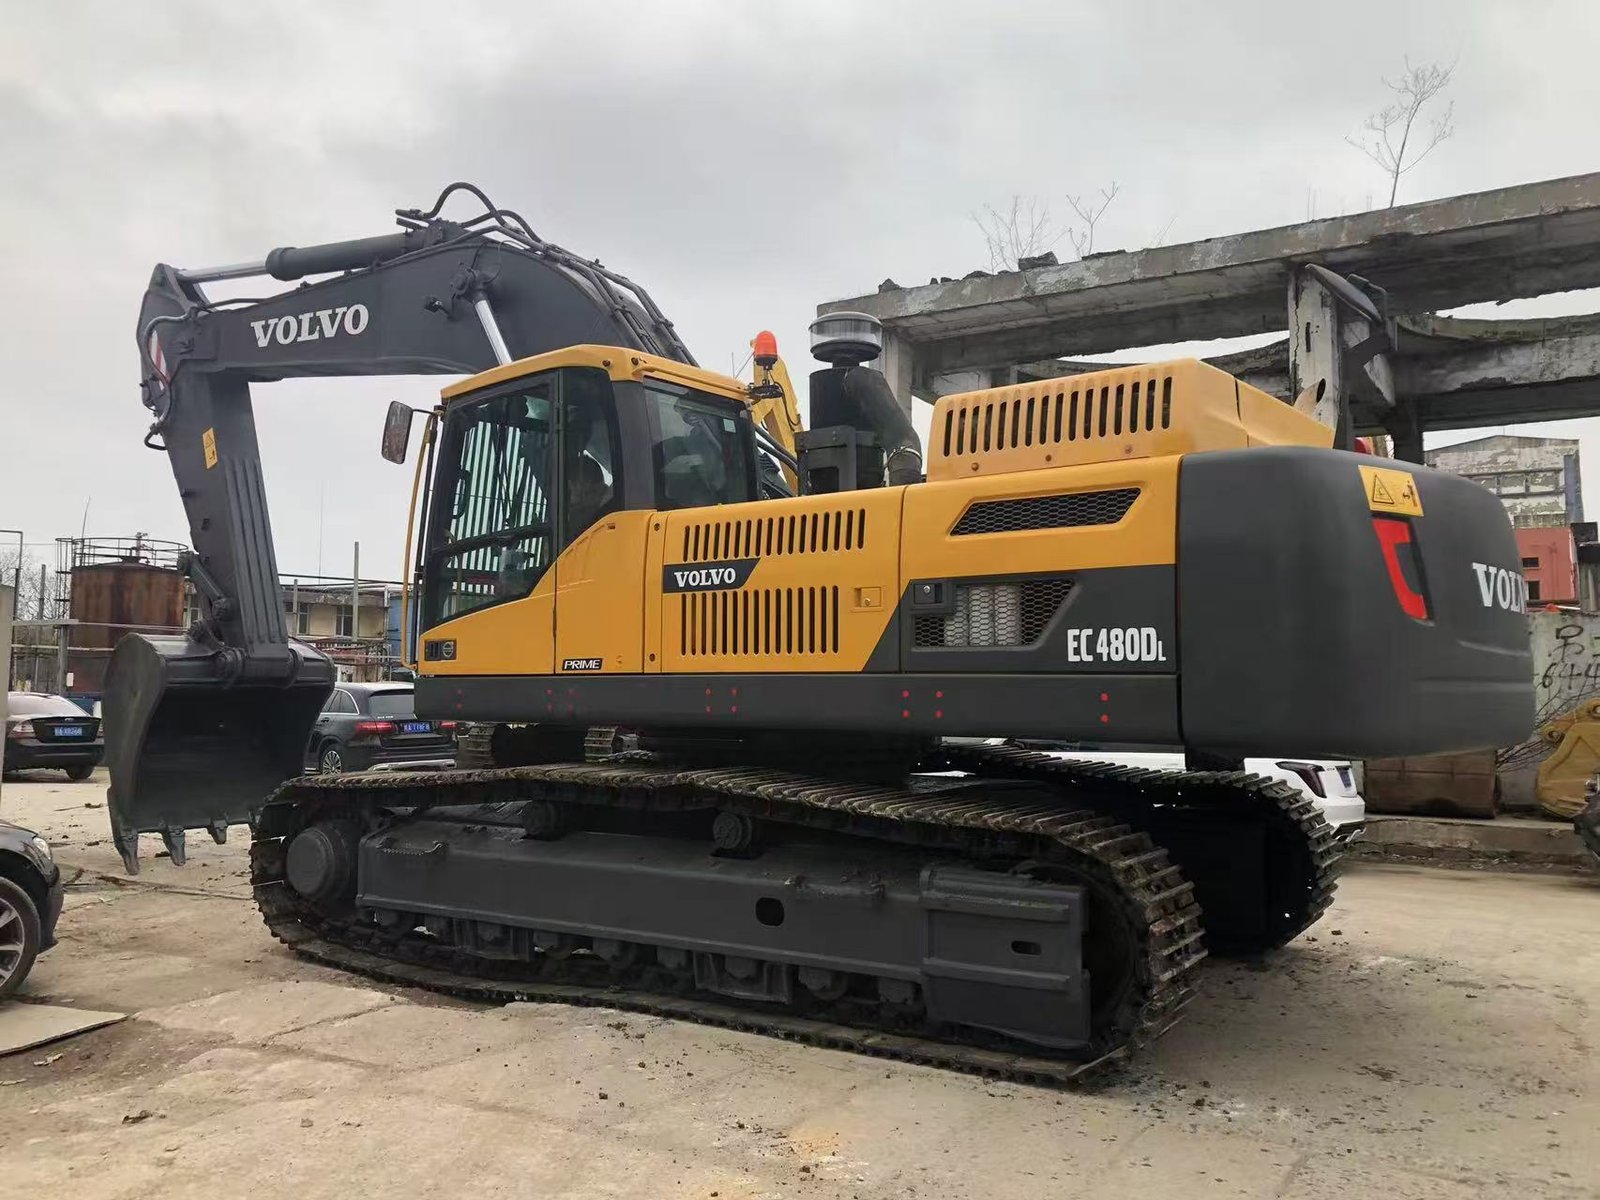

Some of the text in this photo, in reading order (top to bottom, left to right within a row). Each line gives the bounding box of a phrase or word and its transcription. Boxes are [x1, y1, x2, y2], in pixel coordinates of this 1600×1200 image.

[250, 303, 369, 348] VOLVO
[673, 567, 736, 588] VOLVO
[563, 659, 601, 670] PRIME
